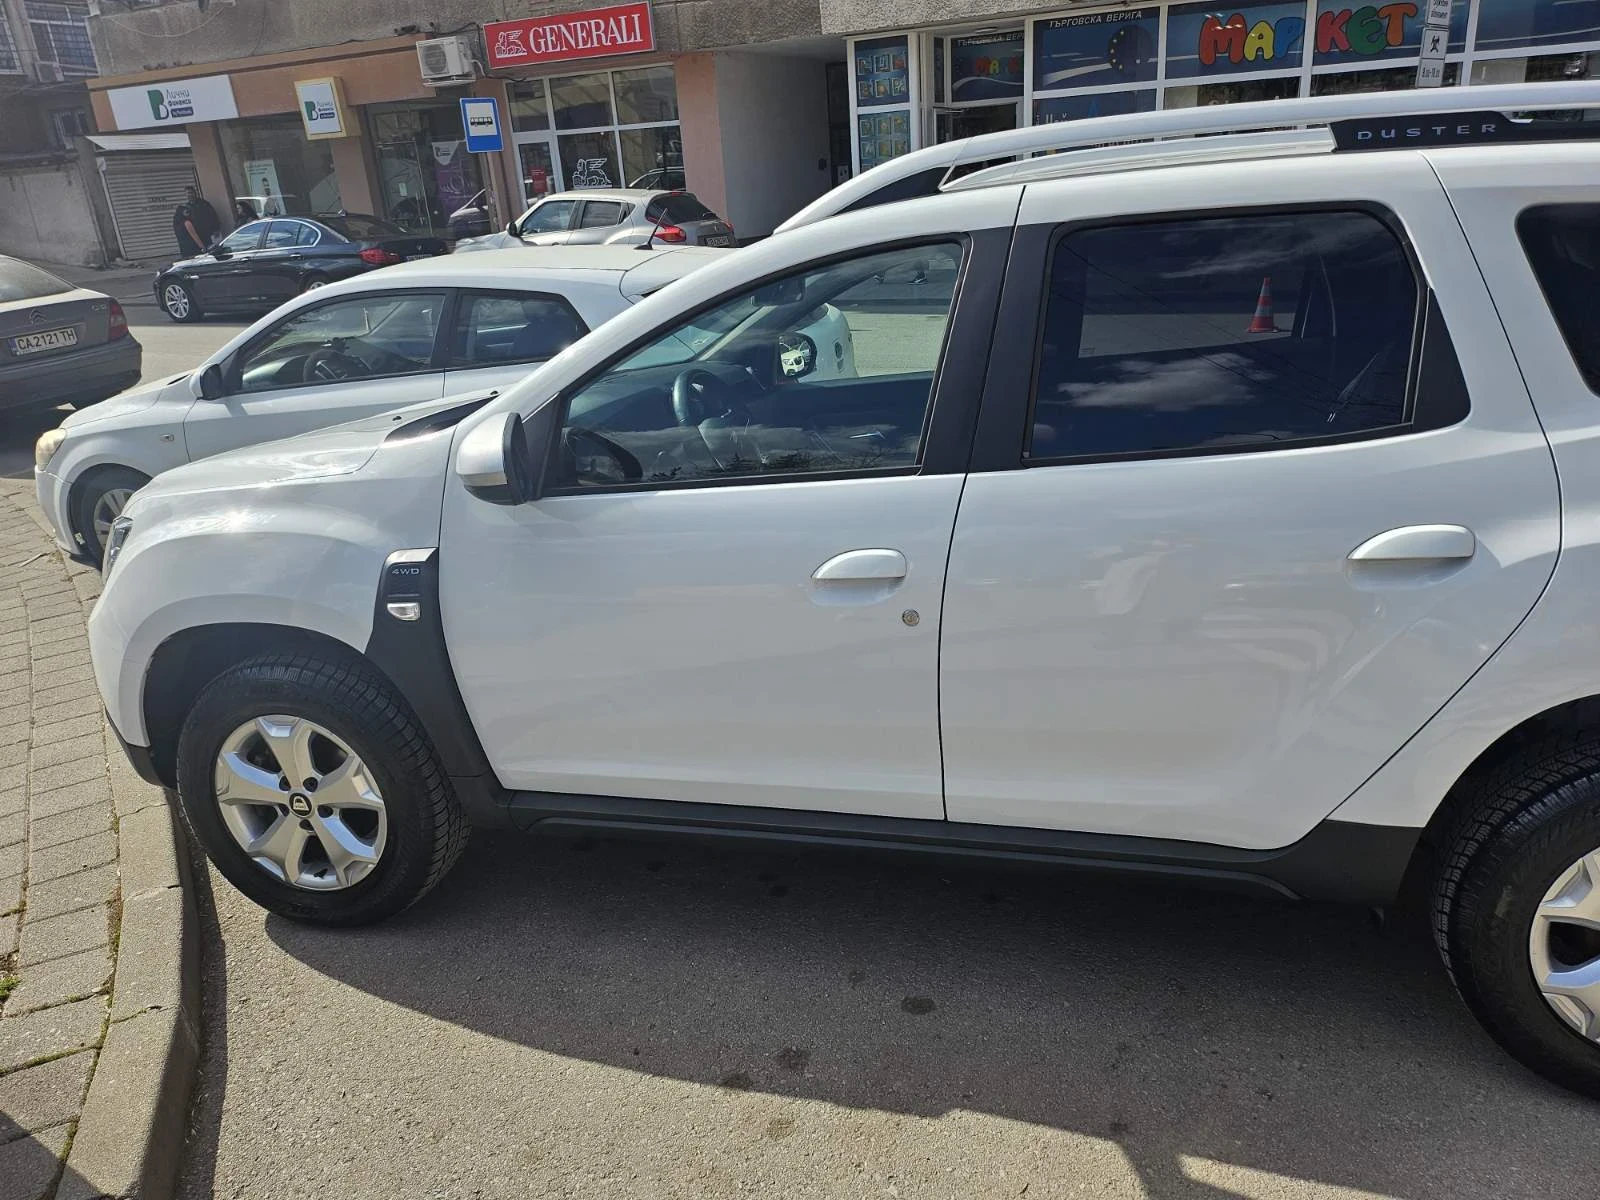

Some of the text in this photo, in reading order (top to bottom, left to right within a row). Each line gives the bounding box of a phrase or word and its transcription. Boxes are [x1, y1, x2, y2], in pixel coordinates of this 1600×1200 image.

[1049, 9, 1143, 28] ТЪРГОВСКА ВЕРИГА
[529, 13, 644, 54] GENERALI
[1357, 123, 1497, 141] DUSTER
[391, 568, 420, 576] 4WD
